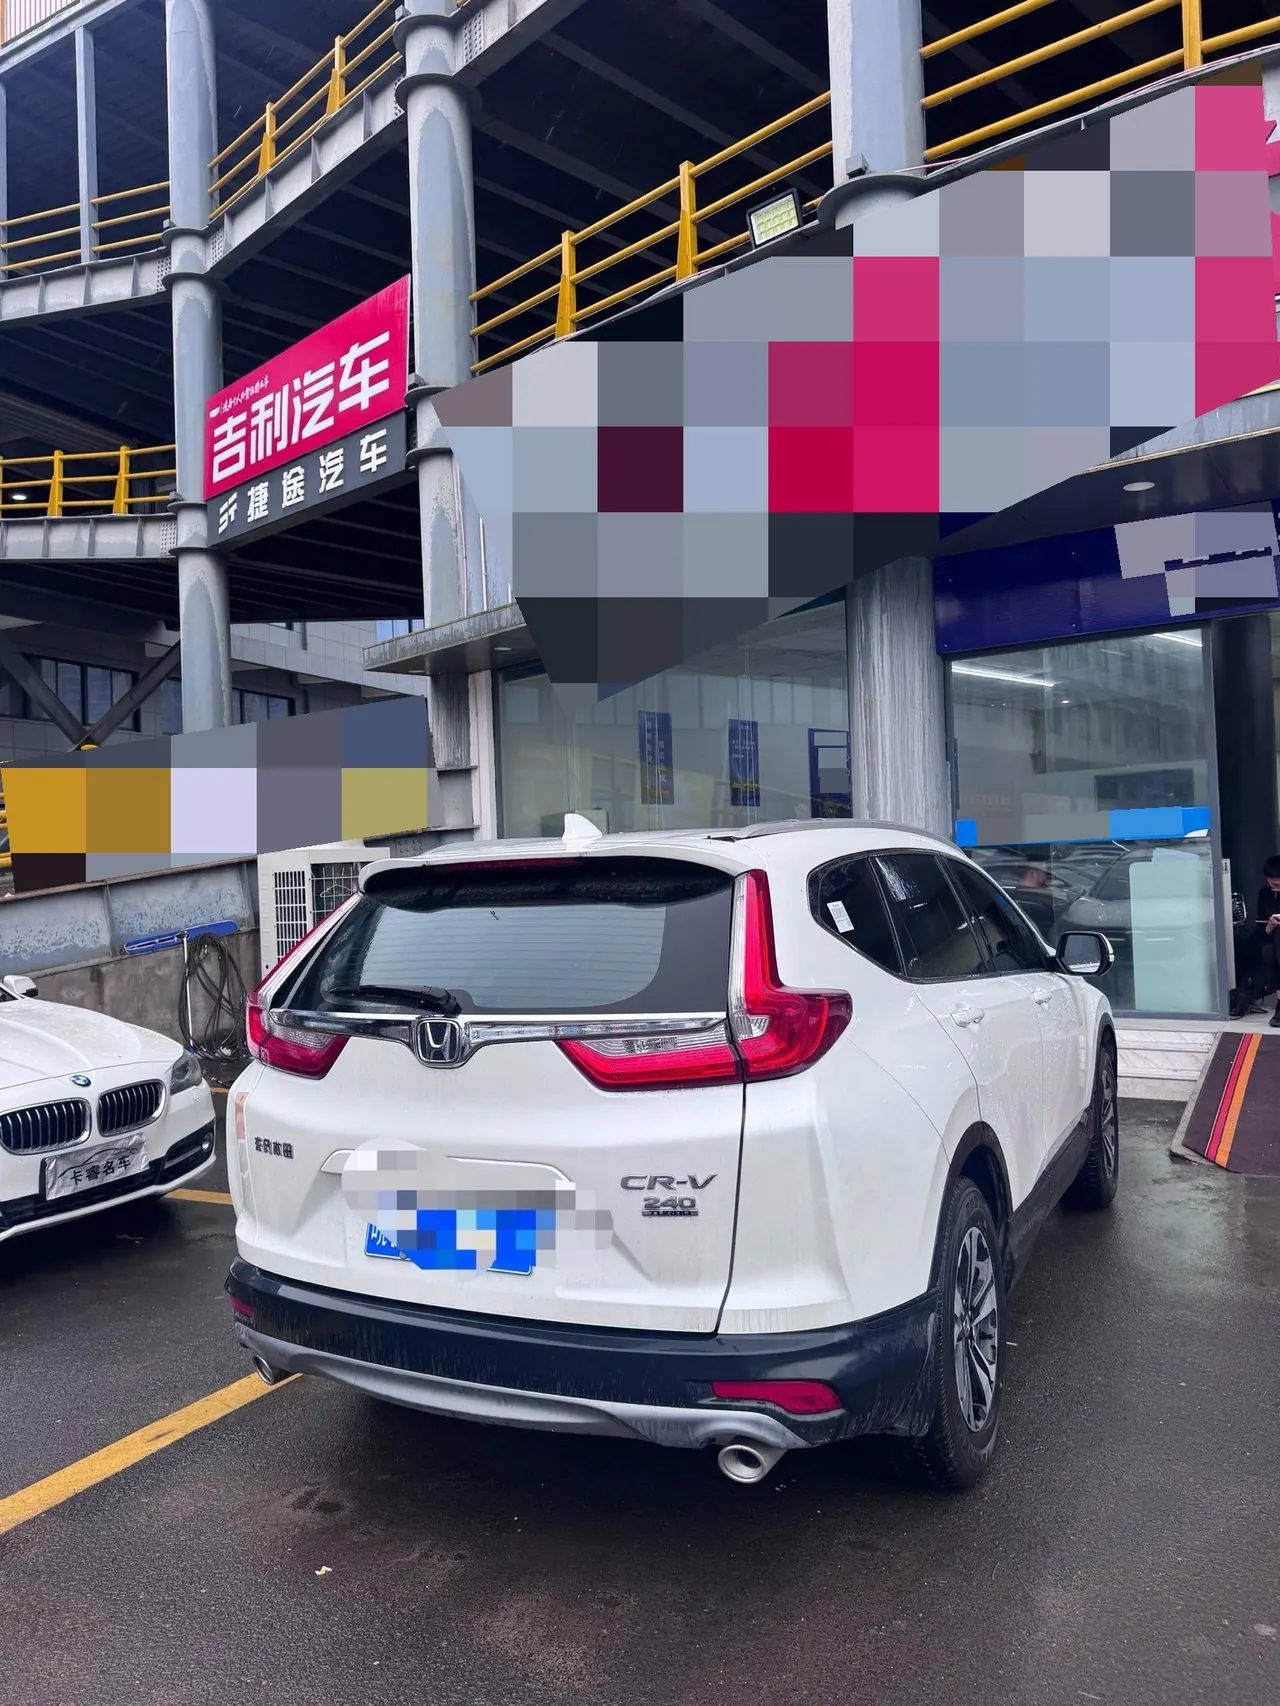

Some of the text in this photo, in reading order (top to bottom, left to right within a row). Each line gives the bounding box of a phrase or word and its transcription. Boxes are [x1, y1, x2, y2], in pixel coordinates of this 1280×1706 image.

[213, 330, 390, 483] 吉利汽车
[247, 428, 387, 522] 捷途汽车
[70, 1156, 131, 1185] 卡睿名车
[620, 1173, 719, 1190] CR-V
[643, 1195, 697, 1209] 240
